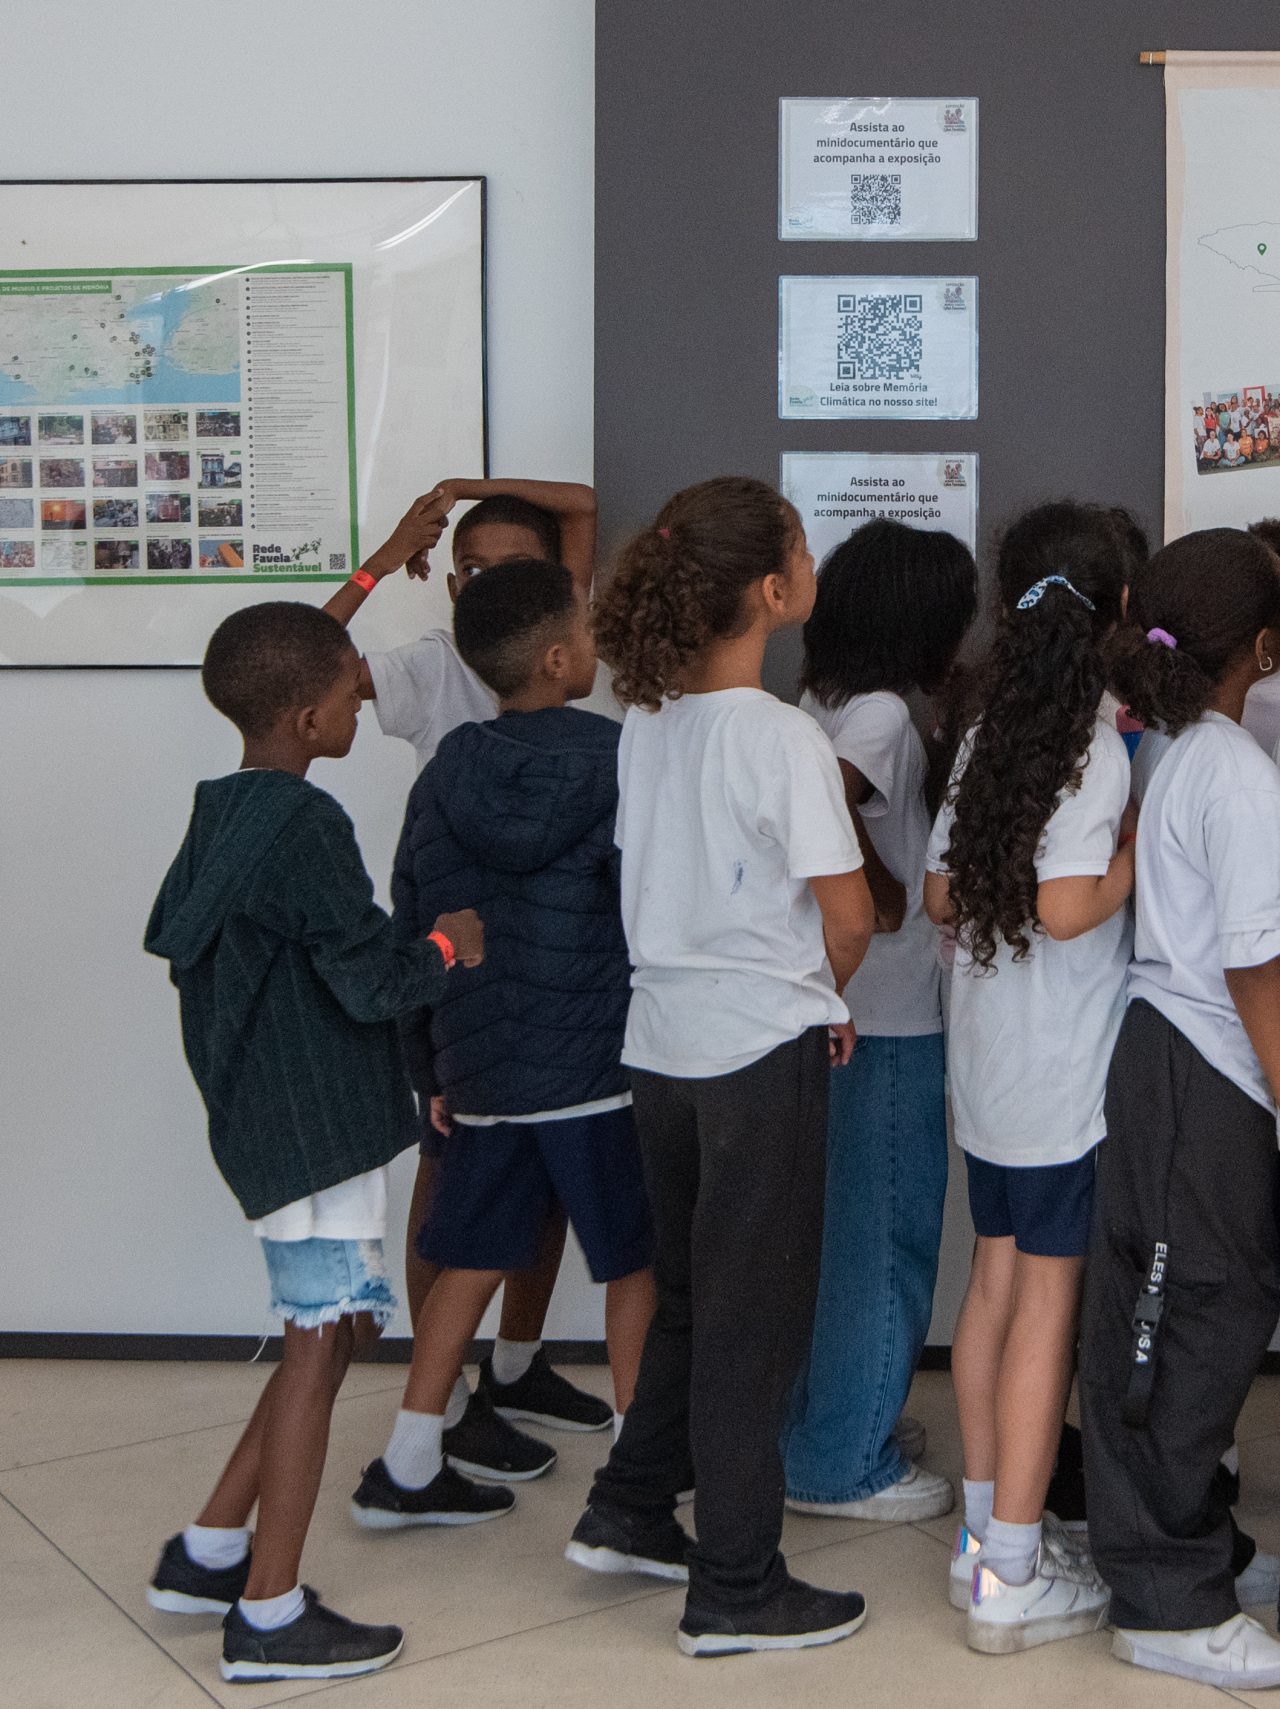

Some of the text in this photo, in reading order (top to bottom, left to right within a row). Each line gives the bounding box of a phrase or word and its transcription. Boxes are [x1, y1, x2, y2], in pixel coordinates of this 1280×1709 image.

[850, 122, 889, 132] Assista
[817, 137, 938, 150] minidocumentário que
[814, 153, 875, 165] acompanha
[888, 153, 940, 165] exposição
[830, 382, 927, 392] Leia sobre Memória
[820, 396, 866, 406] Climática
[916, 398, 937, 406] site!
[851, 477, 905, 487] Assista ao
[817, 492, 938, 504] minidocumentário que
[814, 508, 941, 520] acompanha a exposição
[253, 544, 281, 553] Rede
[253, 554, 291, 563] Favela
[254, 562, 322, 573] Sustentável
